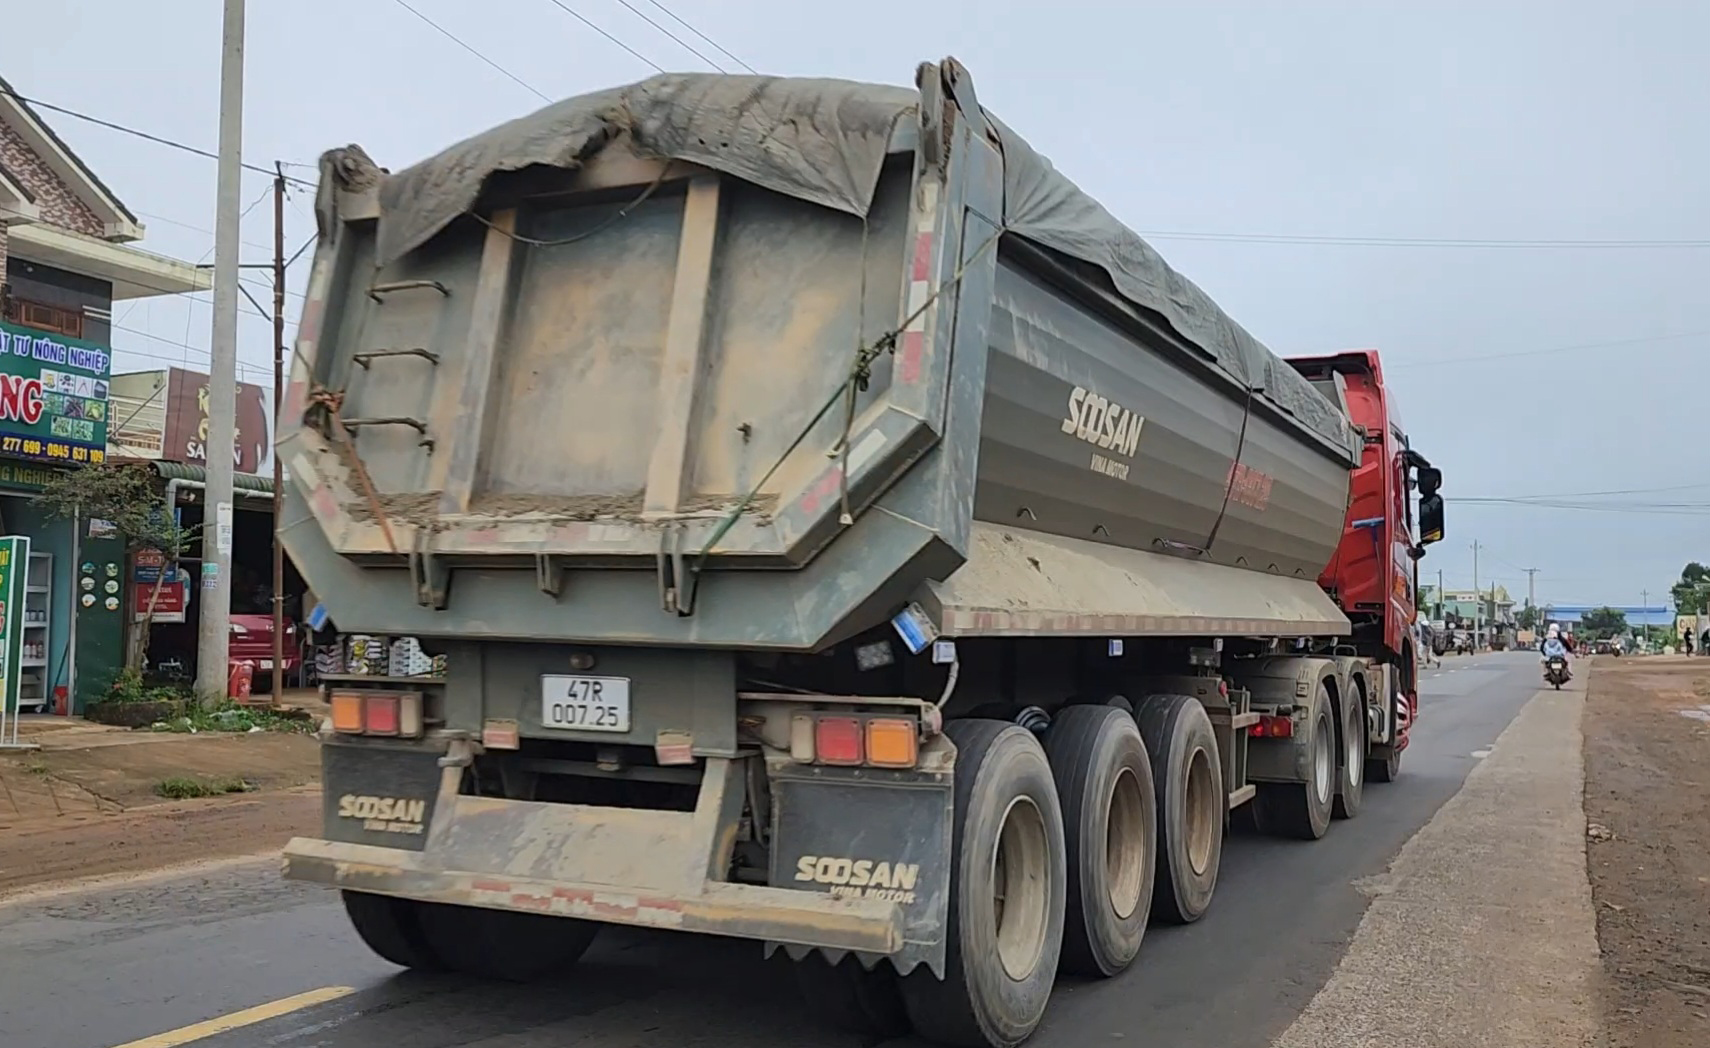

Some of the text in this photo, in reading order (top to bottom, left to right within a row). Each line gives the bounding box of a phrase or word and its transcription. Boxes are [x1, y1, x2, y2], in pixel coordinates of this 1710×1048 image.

[13, 335, 31, 356] TƯ
[33, 337, 66, 364] NÔNG
[68, 346, 109, 375] NGHIỆP
[1061, 386, 1145, 458] SOOSAN
[2, 437, 21, 452] 277
[23, 440, 41, 454] 699
[47, 442, 70, 458] 0945
[72, 446, 88, 461] 631
[568, 680, 603, 702] 47R
[552, 703, 619, 726] 007.25
[338, 794, 425, 823] SOOSAN
[794, 856, 919, 890] SOOSAN
[864, 888, 916, 904] MOTOR
